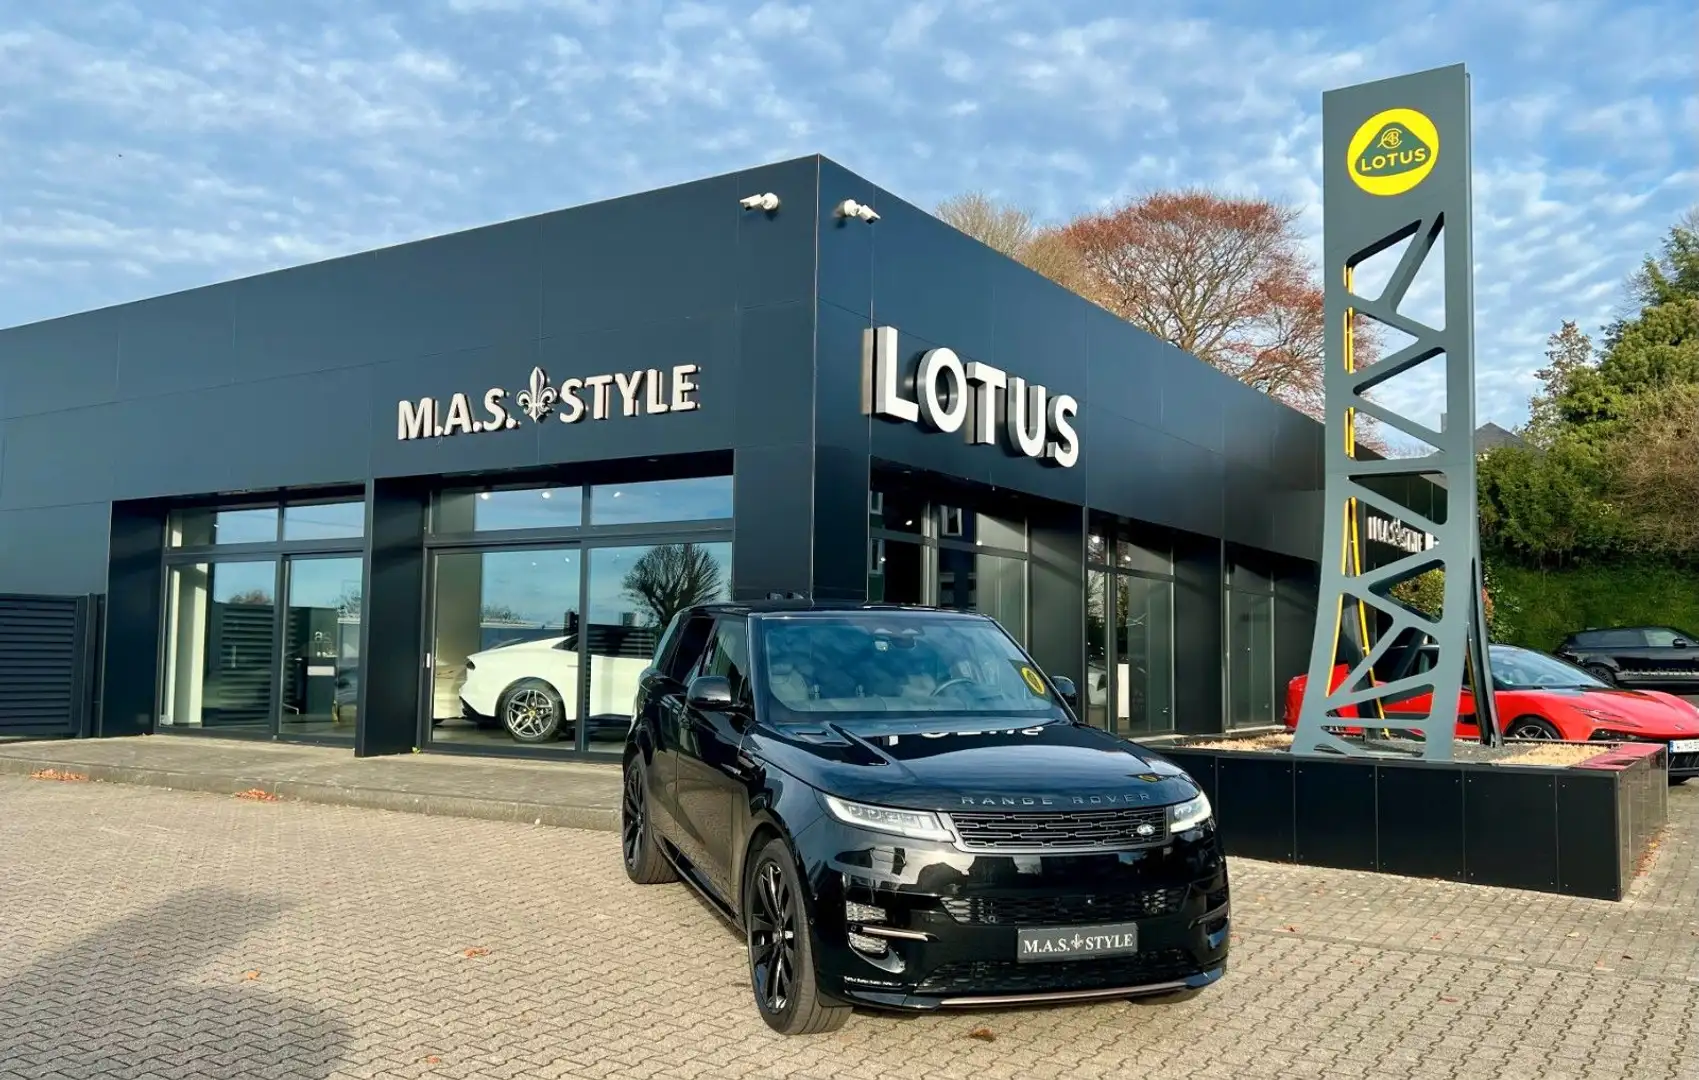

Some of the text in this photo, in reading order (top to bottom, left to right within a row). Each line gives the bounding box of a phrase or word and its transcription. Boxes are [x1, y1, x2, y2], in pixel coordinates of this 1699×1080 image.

[1361, 148, 1426, 171] LOTUS
[397, 364, 701, 440] M.A.S. STYLE
[874, 326, 1079, 467] LOTUS
[961, 793, 1150, 805] RANGE ROVER
[1023, 933, 1133, 953] M.A.S. STYLE
